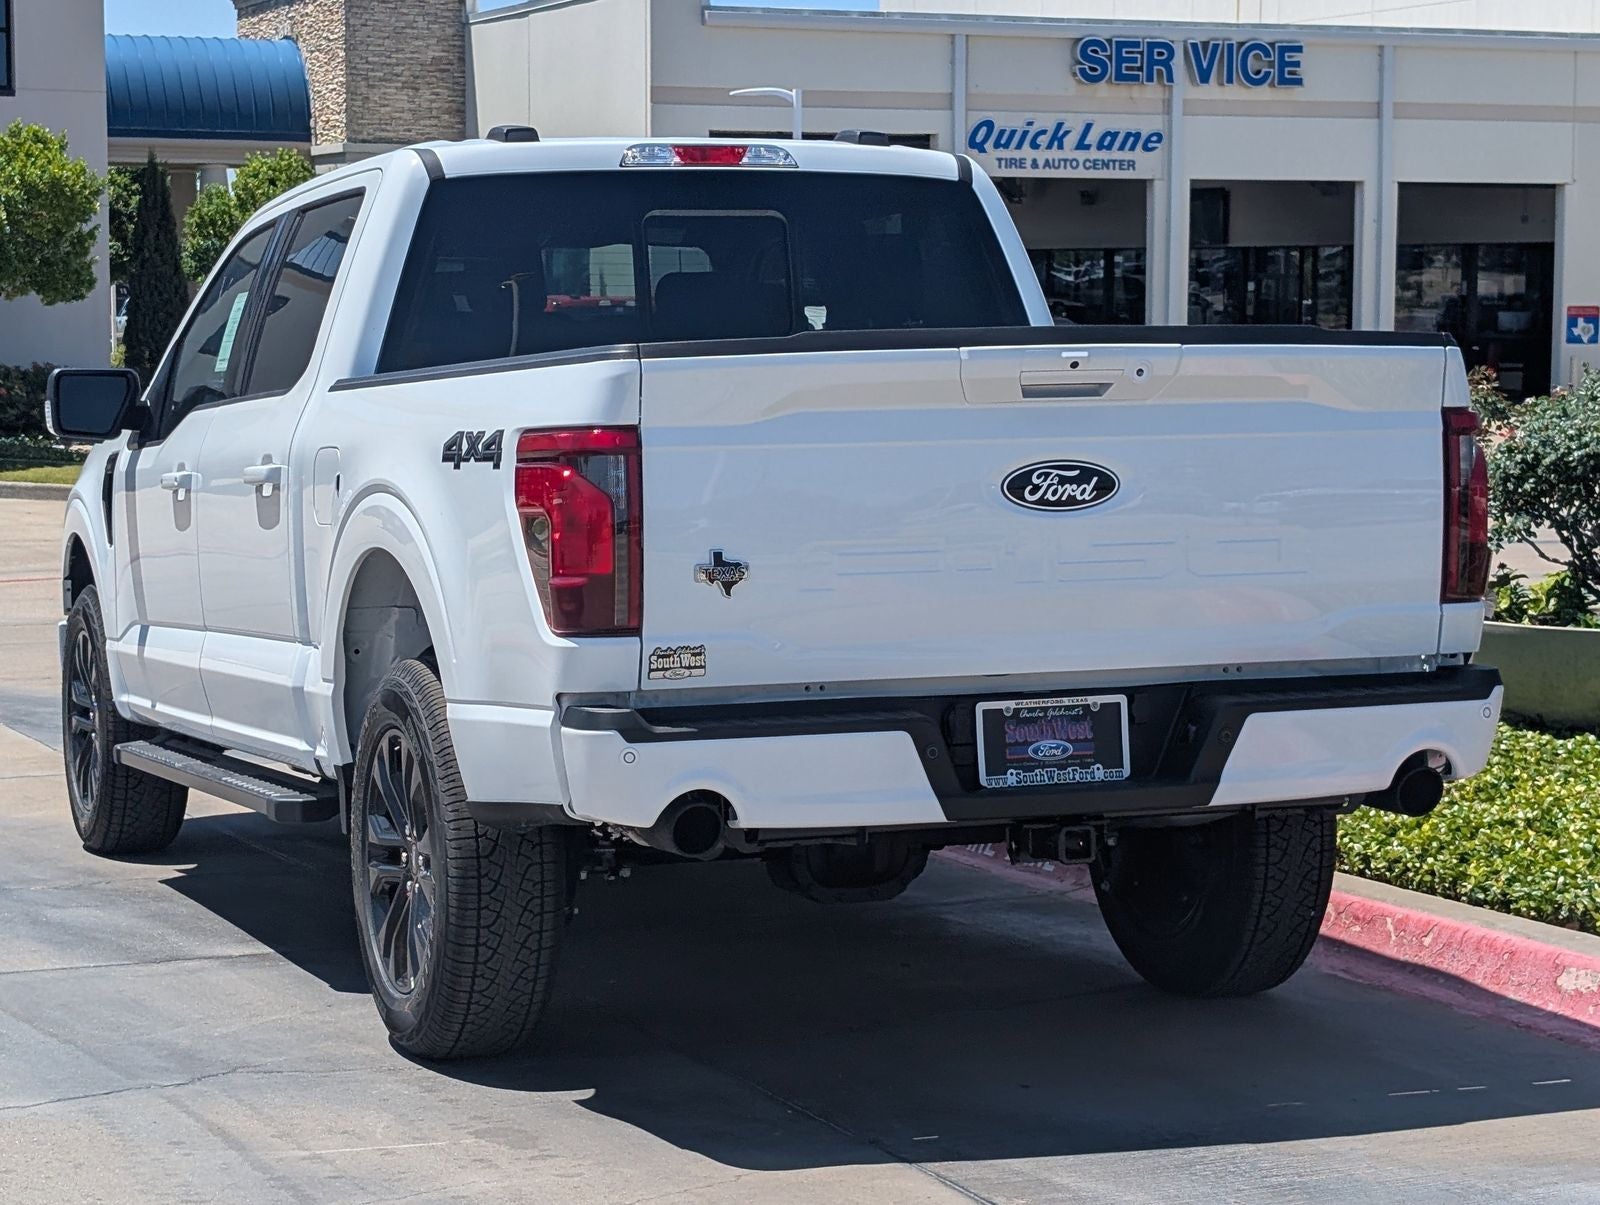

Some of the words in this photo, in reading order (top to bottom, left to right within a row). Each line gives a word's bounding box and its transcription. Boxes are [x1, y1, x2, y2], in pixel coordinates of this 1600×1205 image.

[967, 118, 1073, 153] Quick
[1073, 119, 1164, 154] Lane
[995, 157, 1027, 170] TIRE
[1030, 158, 1040, 170] &
[1042, 158, 1080, 171] AUTO
[1082, 158, 1136, 172] CENTER
[1024, 468, 1098, 501] Ford
[701, 566, 746, 580] TEXAS
[1038, 743, 1064, 757] Ford
